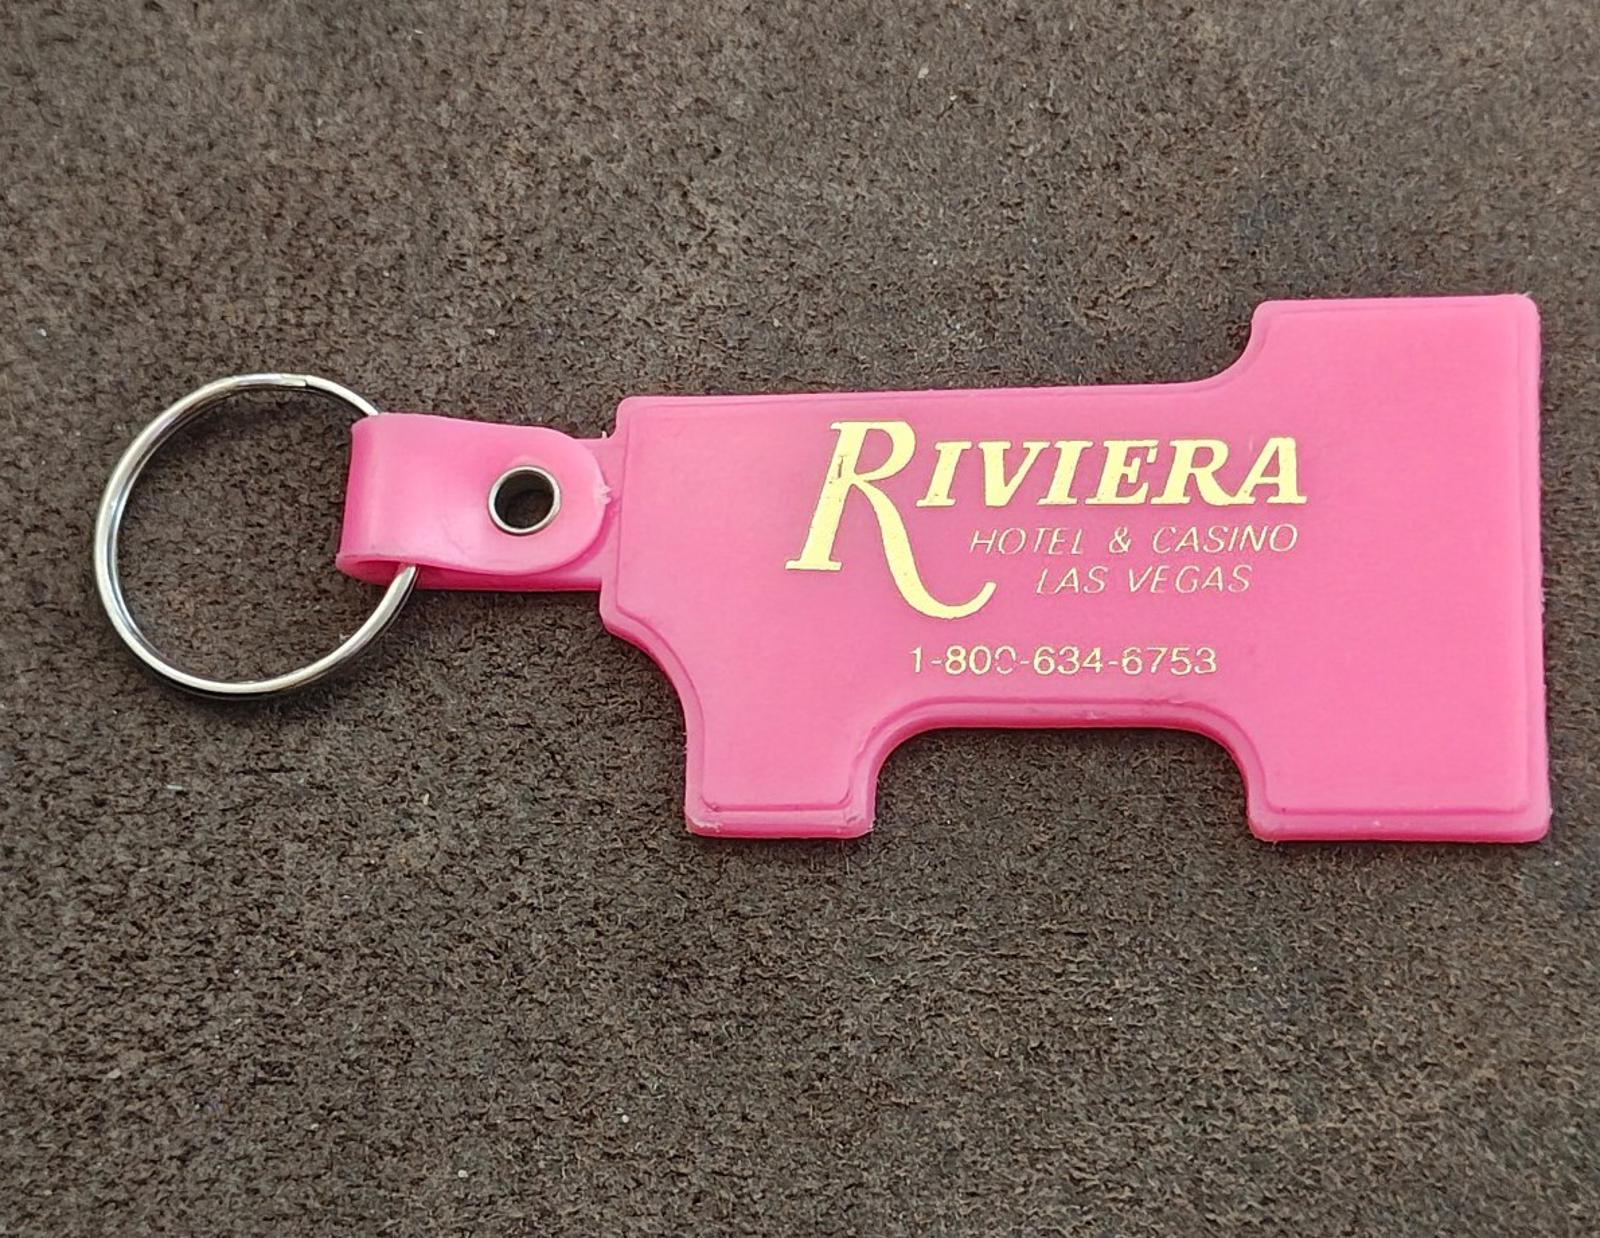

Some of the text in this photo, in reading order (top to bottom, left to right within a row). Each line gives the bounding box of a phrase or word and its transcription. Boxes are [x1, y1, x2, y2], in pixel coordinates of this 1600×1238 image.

[784, 418, 1308, 620] RIVIERA
[969, 523, 1299, 555] HOTEL & CASINO
[1035, 563, 1252, 594] LAS VEGAS
[909, 644, 1218, 676] 1-800-634-6753
